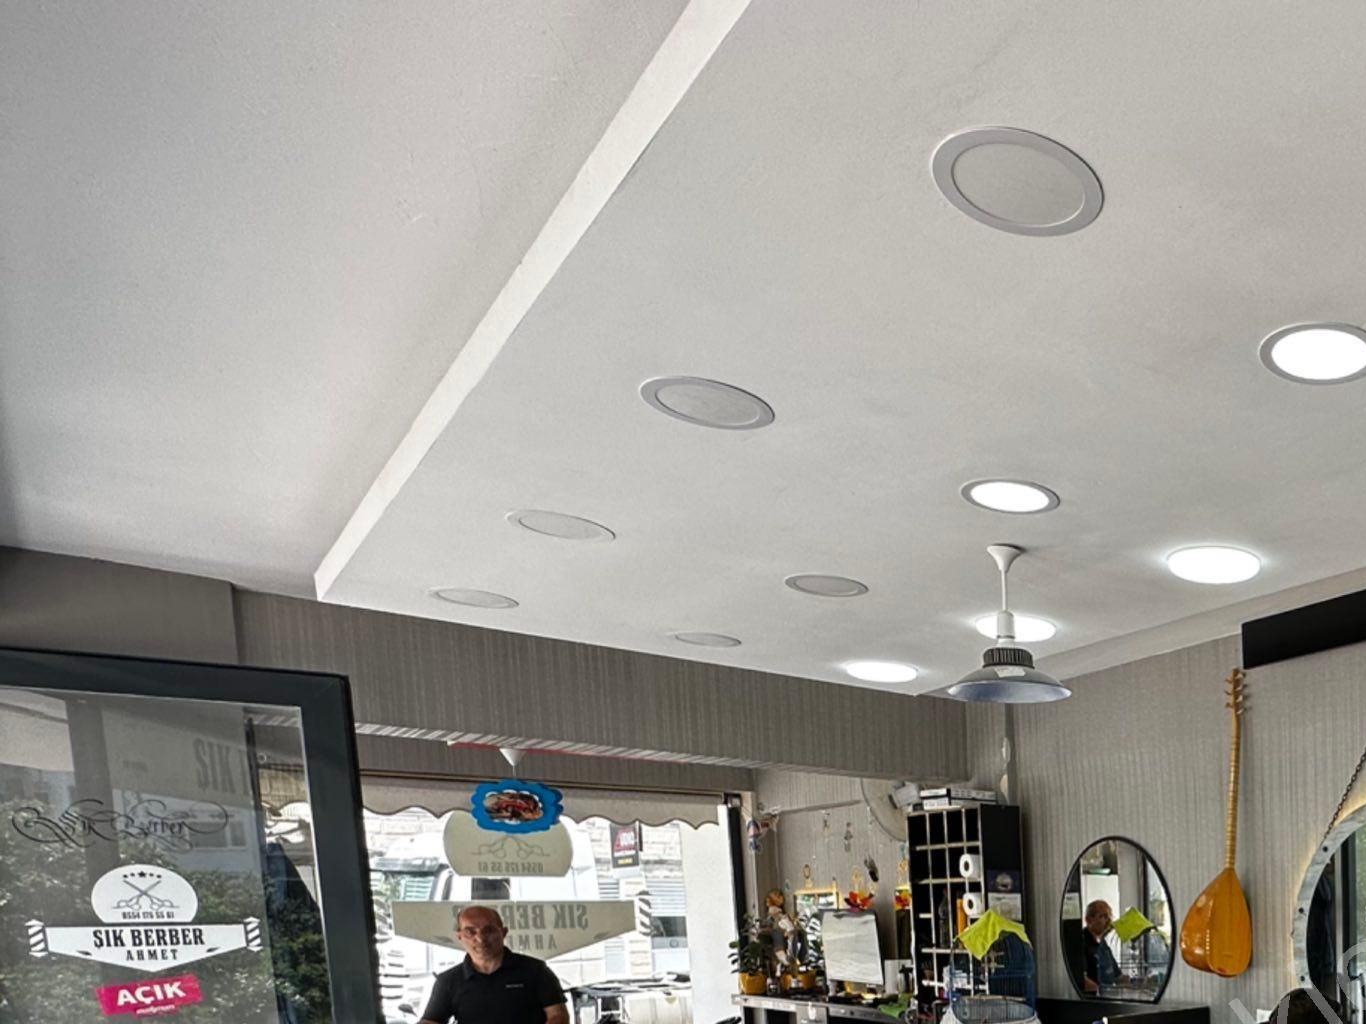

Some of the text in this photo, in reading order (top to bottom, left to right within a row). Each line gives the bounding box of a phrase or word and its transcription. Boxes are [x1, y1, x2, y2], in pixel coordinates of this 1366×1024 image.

[132, 928, 205, 947] BERBER
[126, 949, 178, 961] AHMET
[117, 981, 186, 1006] AÇIK
